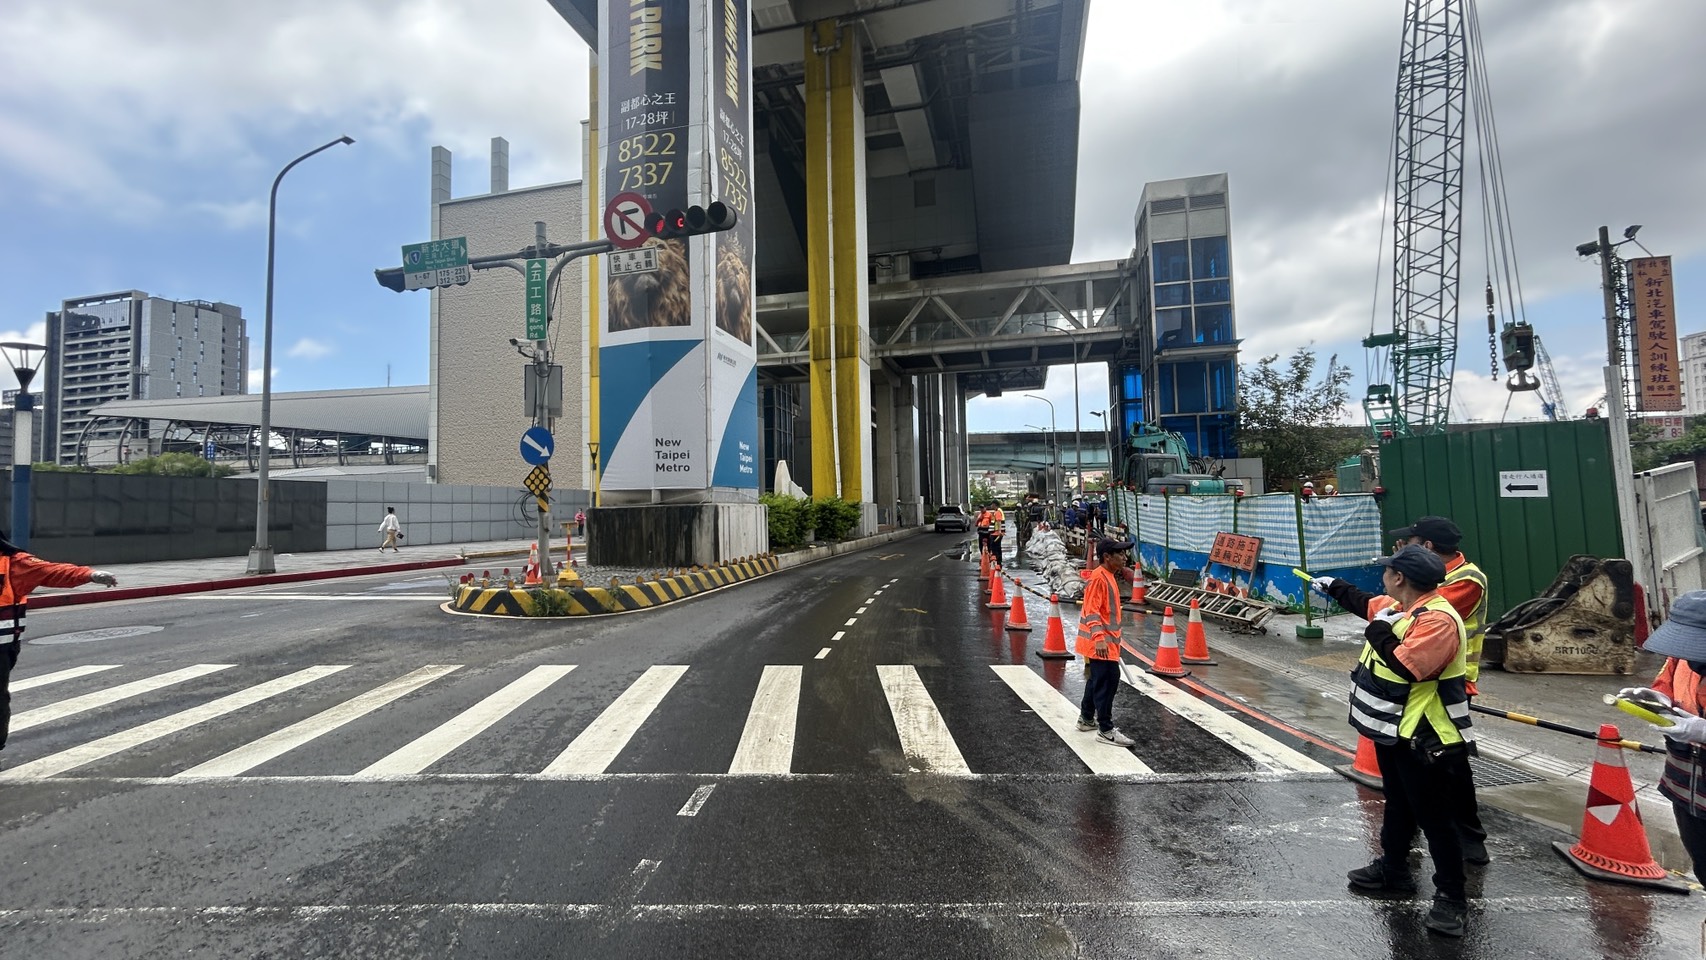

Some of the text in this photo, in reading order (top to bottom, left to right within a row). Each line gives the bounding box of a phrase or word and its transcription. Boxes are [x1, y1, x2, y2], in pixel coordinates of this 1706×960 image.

[630, 6, 663, 76] PARK
[725, 42, 739, 108] PARK
[620, 92, 676, 114] 副都心之王
[625, 111, 669, 130] 17-28坪
[618, 132, 676, 163] 8522
[619, 161, 673, 191] 7337
[721, 147, 748, 193] 8522
[723, 175, 748, 215] 7337
[420, 239, 460, 254] 新北大道
[613, 250, 652, 264] 快車道
[613, 259, 653, 273] 禁止右轉
[530, 269, 542, 316] 五工路
[1645, 278, 1671, 383] 新北汽車駕駛人訓練班
[655, 437, 682, 447] New
[739, 441, 750, 451] New
[655, 450, 690, 461] Taipei
[739, 452, 753, 463] Taipei
[655, 463, 691, 472] Metro
[739, 464, 753, 474] Metro
[1216, 535, 1256, 553] 道路施工
[1213, 548, 1253, 567] 車輛改道
